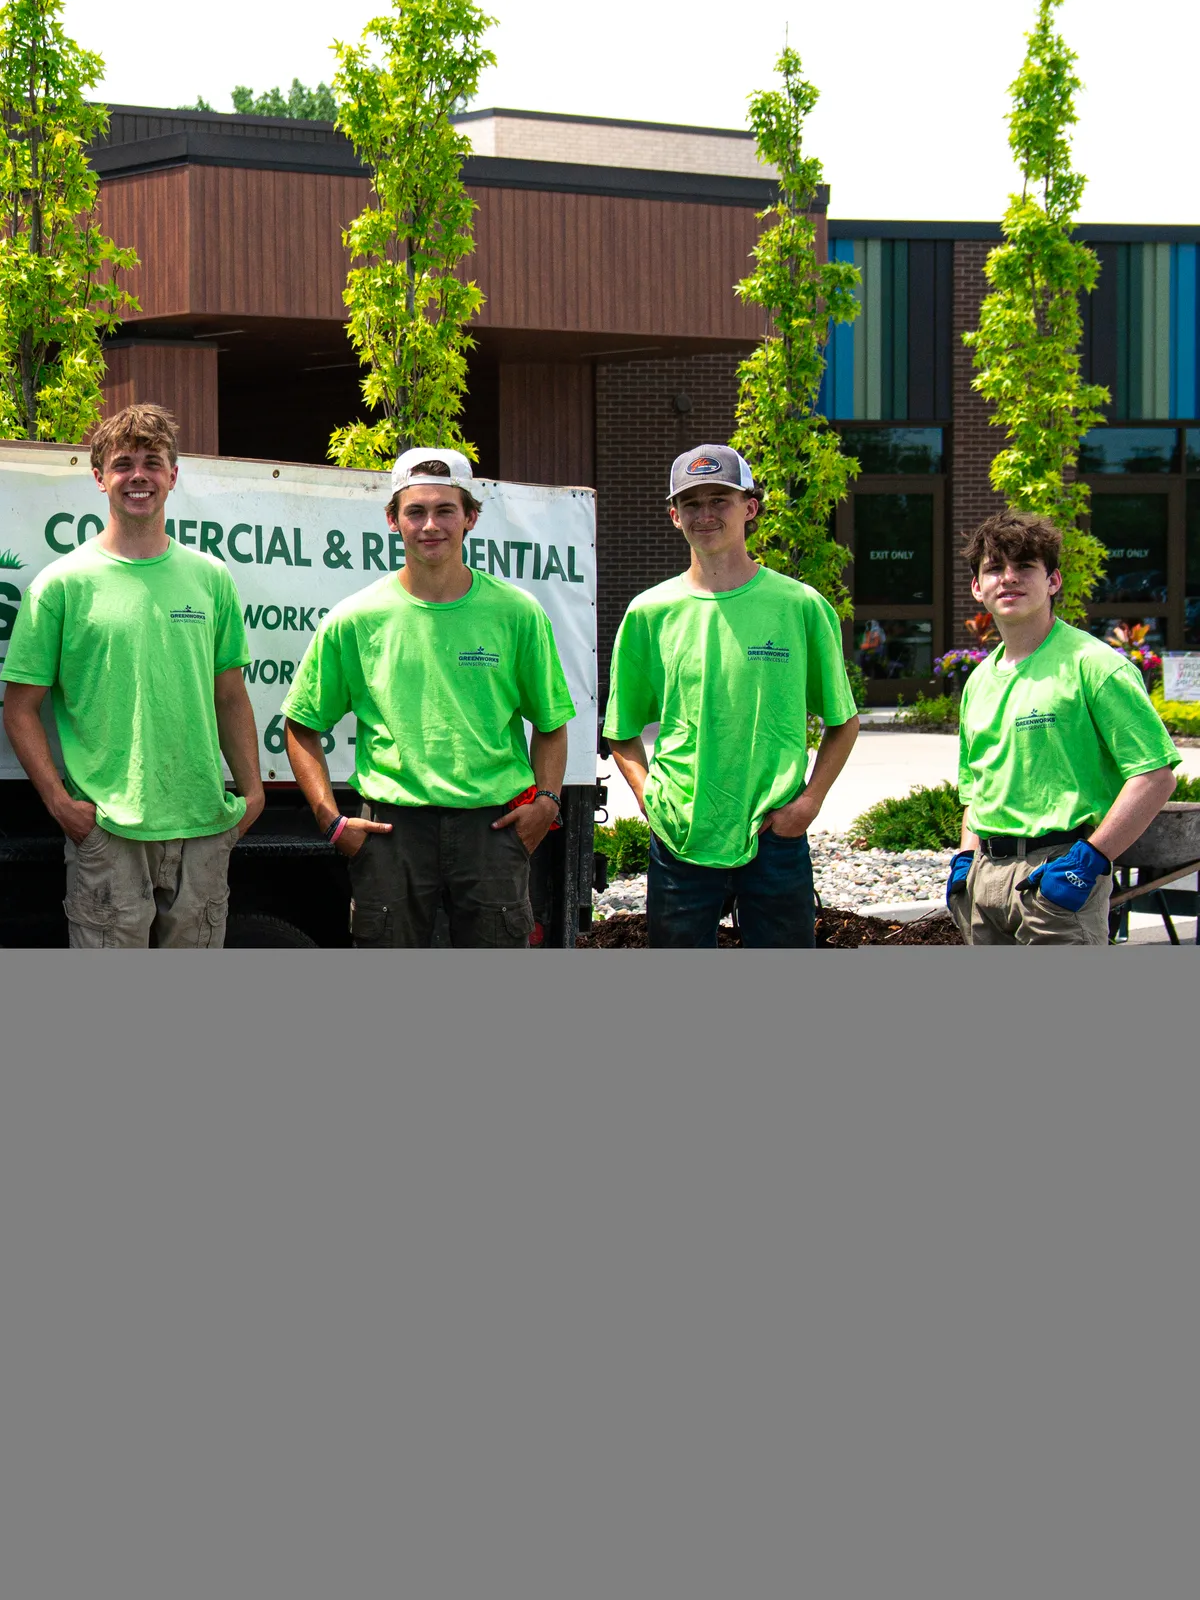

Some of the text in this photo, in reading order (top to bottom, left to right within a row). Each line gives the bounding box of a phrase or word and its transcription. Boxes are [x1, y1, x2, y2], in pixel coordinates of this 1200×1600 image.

[44, 512, 585, 584] COERCIAL & REENTIAL
[870, 550, 914, 560] EXIT ONLY
[1126, 549, 1149, 559] ONLY
[458, 655, 499, 663] GREENWORKS
